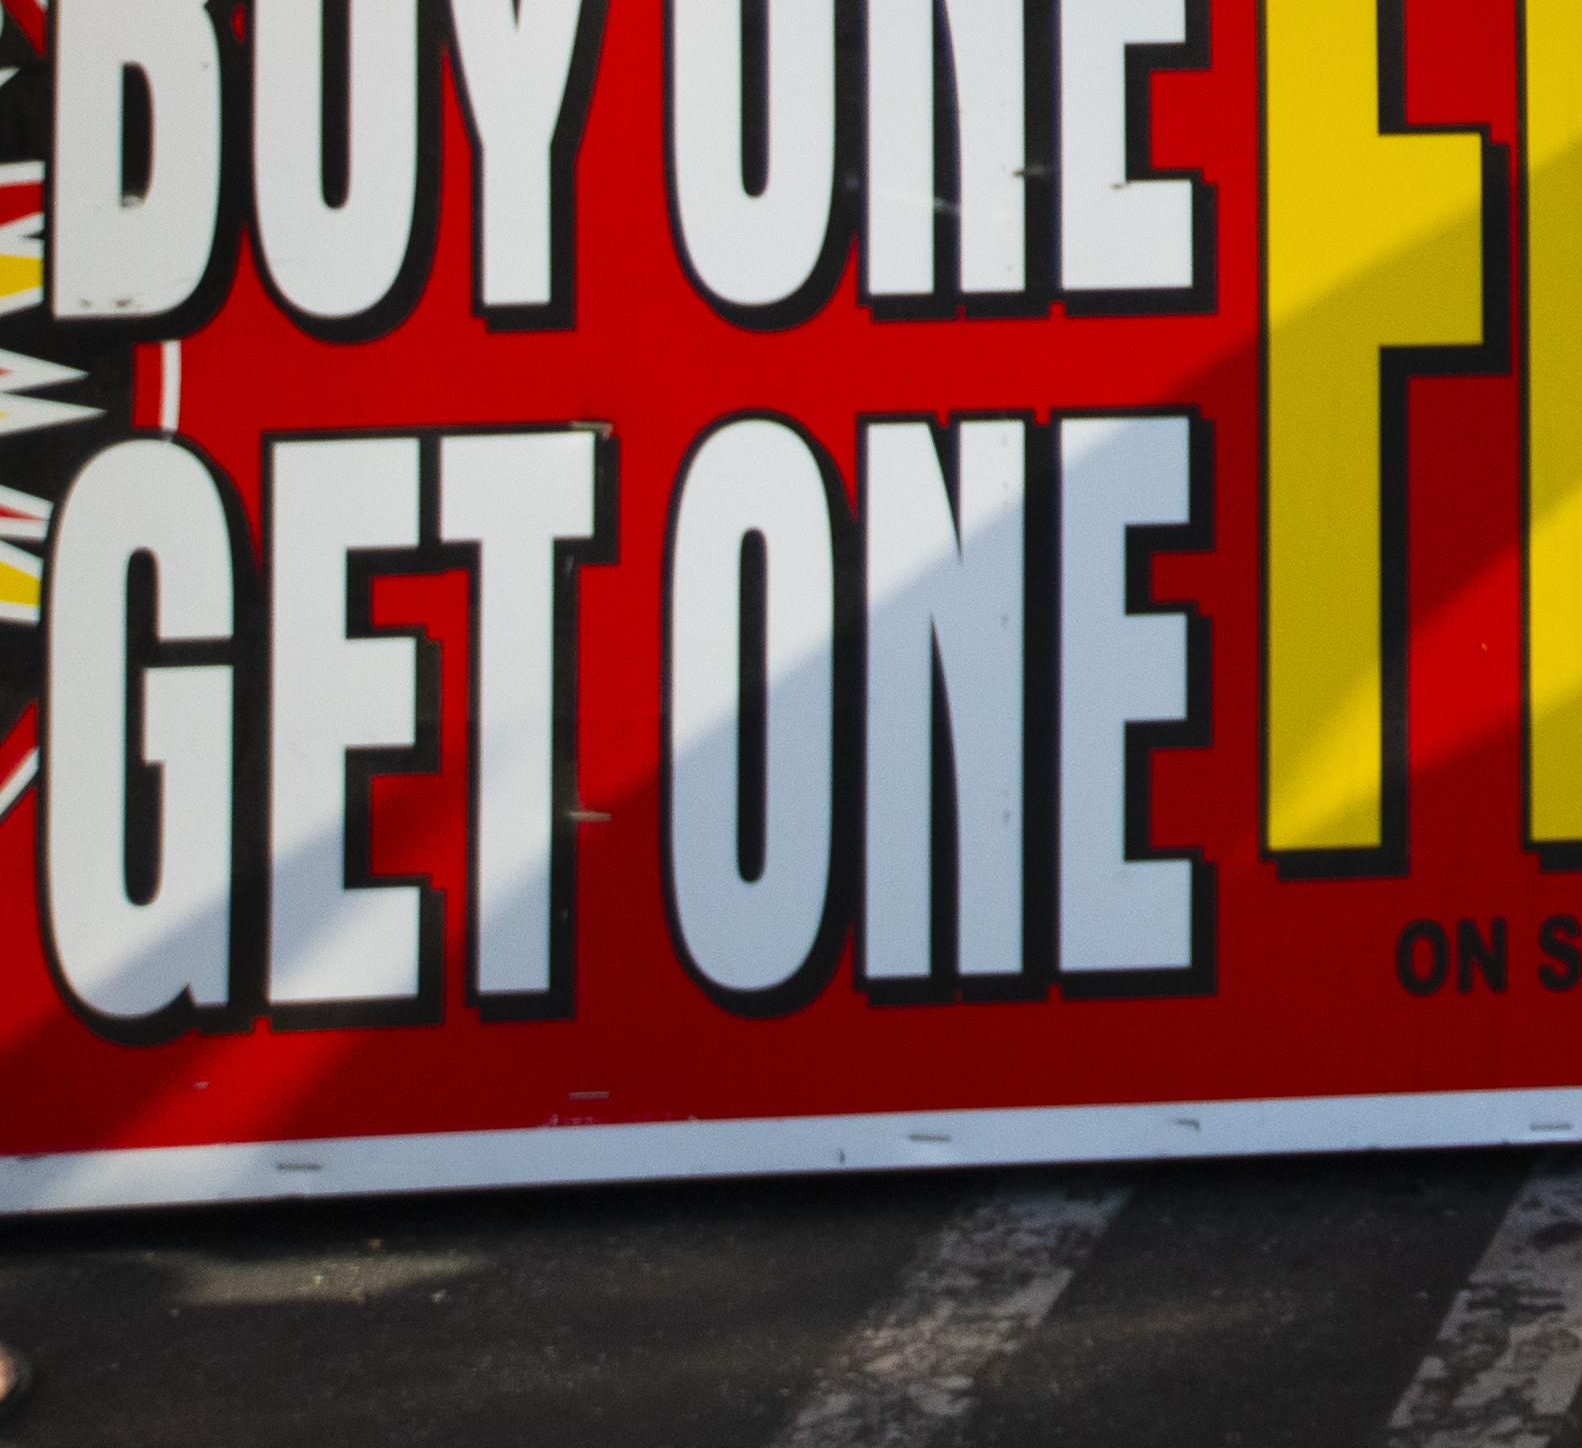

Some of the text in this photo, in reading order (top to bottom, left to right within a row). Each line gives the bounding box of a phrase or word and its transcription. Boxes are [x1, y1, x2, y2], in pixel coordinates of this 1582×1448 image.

[42, 410, 1212, 1035] GET ONE
[1395, 917, 1508, 995] ON
